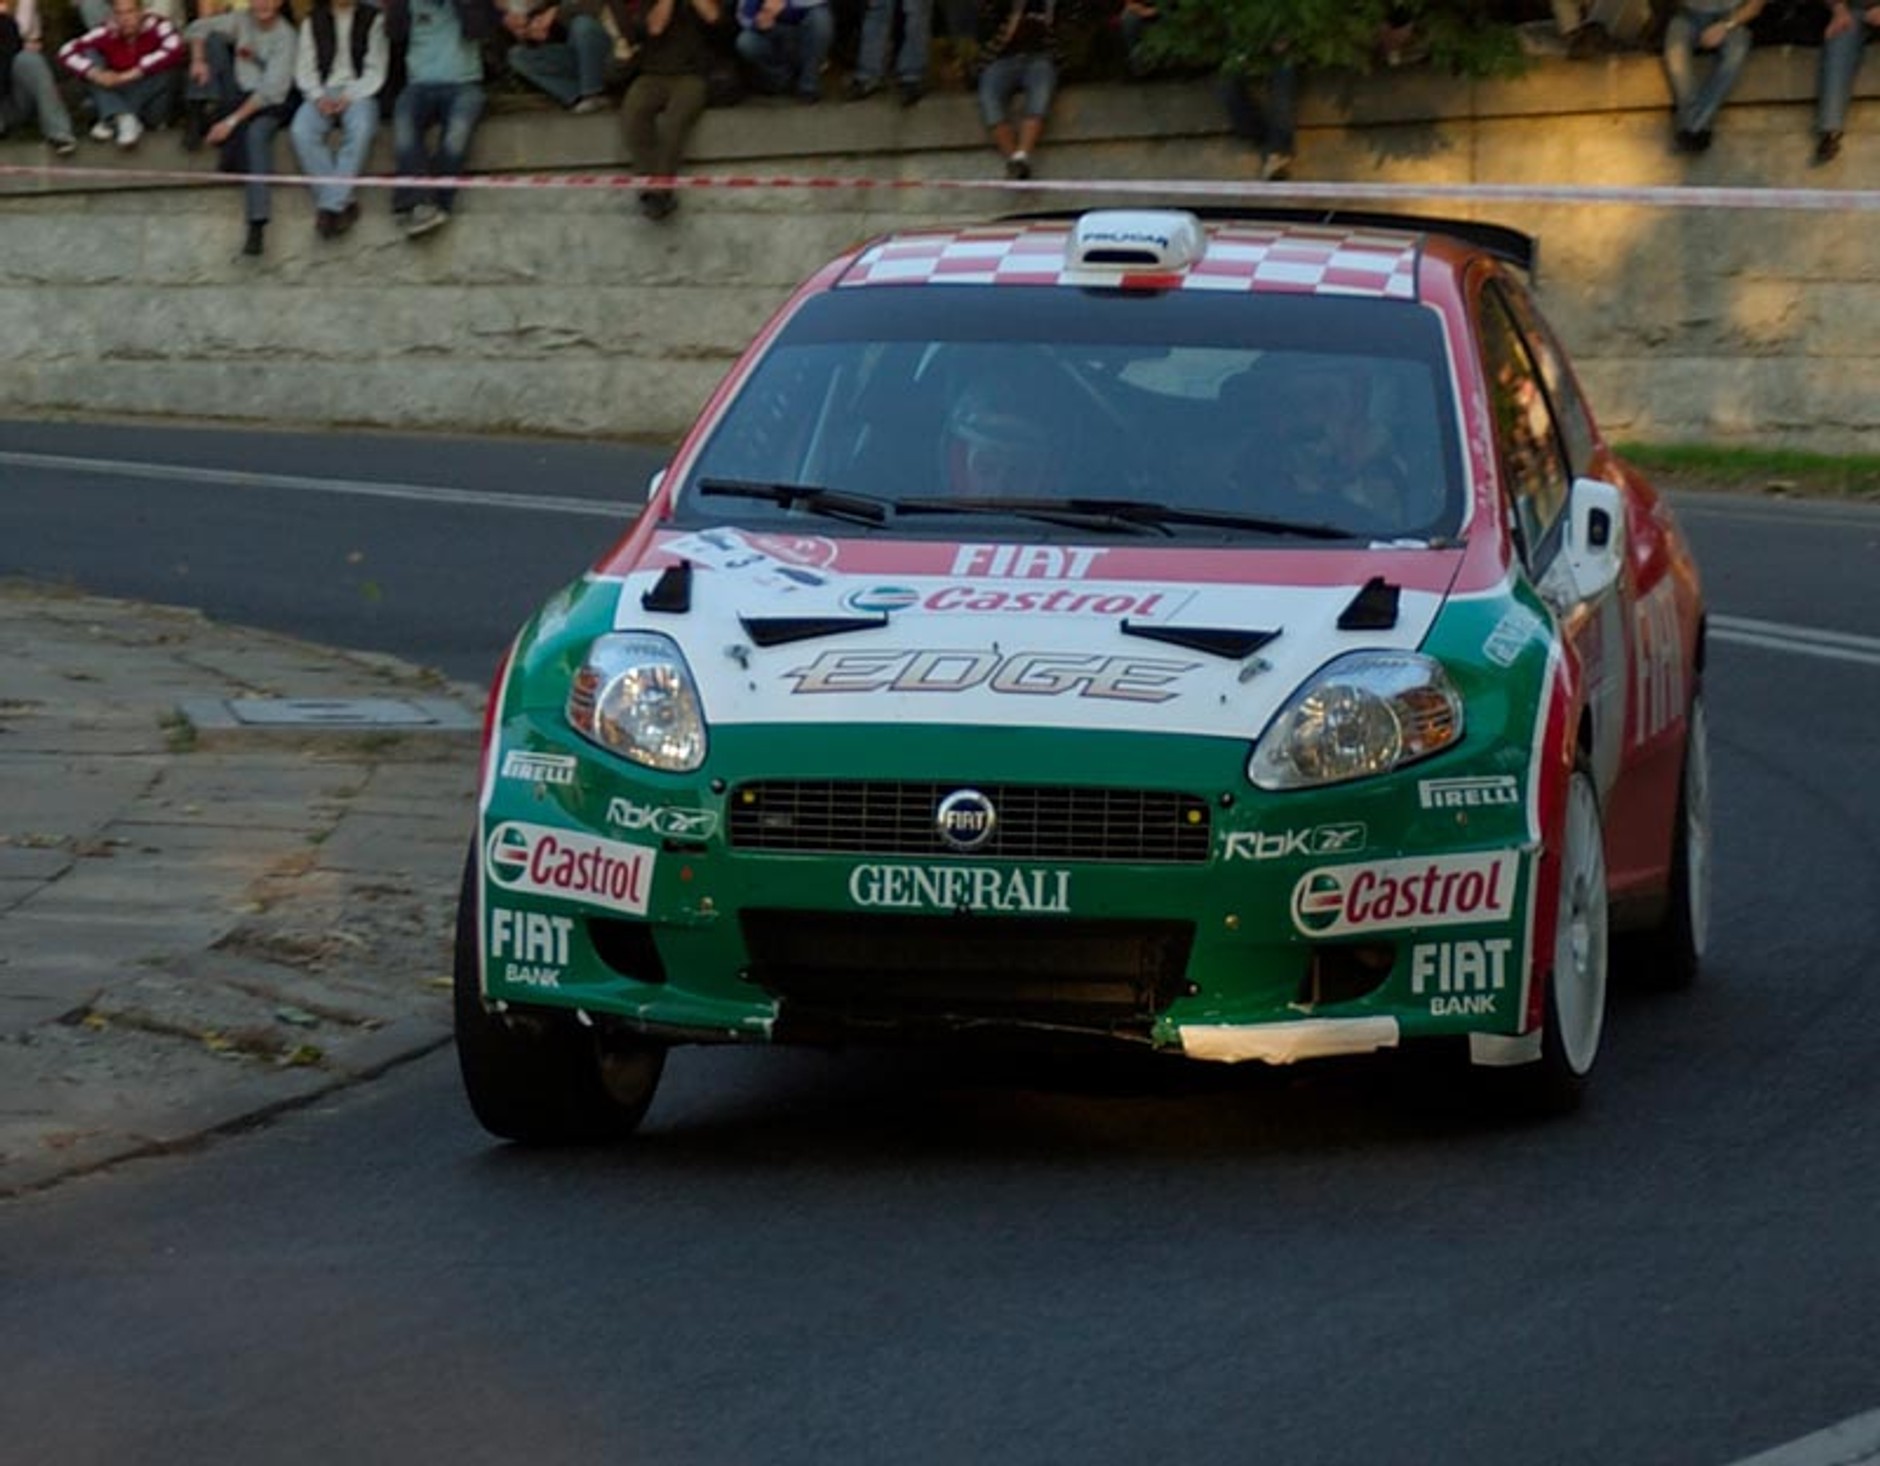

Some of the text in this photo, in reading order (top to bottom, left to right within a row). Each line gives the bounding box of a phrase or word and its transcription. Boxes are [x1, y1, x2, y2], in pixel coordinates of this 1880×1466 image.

[950, 545, 1109, 578] FIAT
[923, 586, 1164, 616] Castrol
[782, 650, 1204, 703] EDGE
[501, 751, 577, 784] PIRELLI
[1419, 776, 1518, 808] PIRELLI
[947, 810, 984, 830] FIAT
[530, 836, 641, 903] Castrol
[849, 864, 1071, 913] GENERALI
[1346, 860, 1503, 924] Castrol
[491, 908, 574, 965] FIAT
[505, 963, 561, 987] BANK
[1411, 939, 1513, 994] FIAT
[1430, 994, 1497, 1016] BANK
